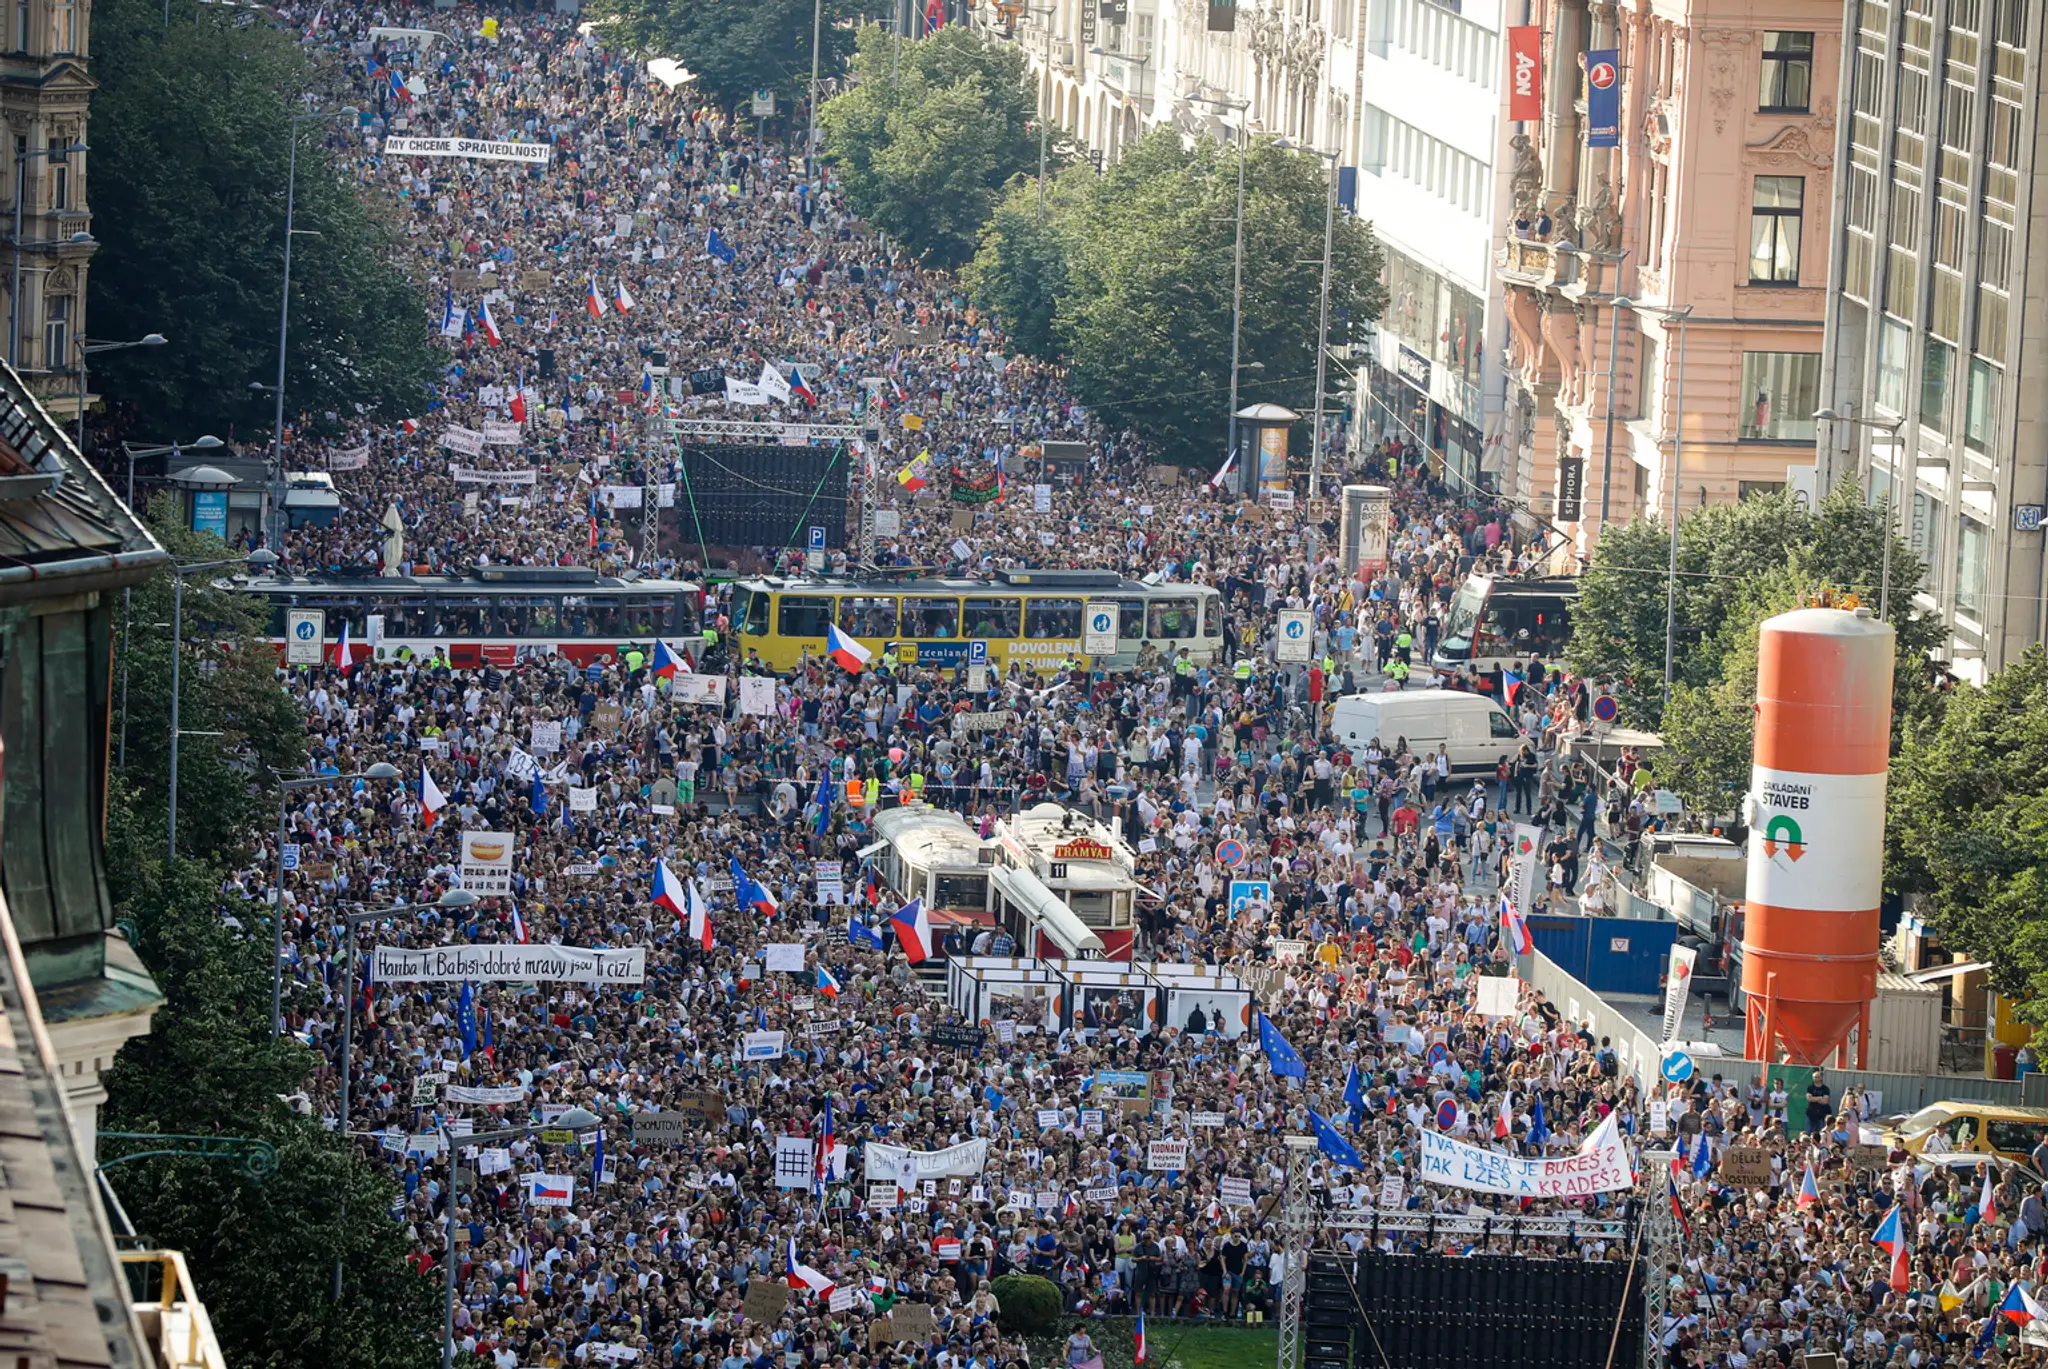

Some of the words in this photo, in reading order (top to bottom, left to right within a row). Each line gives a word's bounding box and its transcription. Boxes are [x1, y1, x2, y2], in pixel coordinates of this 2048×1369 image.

[1515, 51, 1535, 97] AON
[388, 139, 405, 150] MY
[409, 140, 451, 151] CHCEME
[457, 141, 548, 158] SPRAVEDLNOST!
[1566, 464, 1576, 515] SEPHORA
[1008, 640, 1082, 655] DOVOLENÁ
[1763, 780, 1813, 796] ZAKLÁDÁNÍ
[1762, 792, 1810, 810] STAVEB
[1056, 846, 1111, 859] TRAMVAJ
[1054, 864, 1065, 877] 11
[1278, 943, 1302, 951] POZOR
[378, 951, 418, 976] Hanba
[525, 958, 566, 979] mravy
[569, 958, 592, 977] jsou
[634, 1120, 682, 1131] CHOMUTOVA
[1423, 1128, 1456, 1155] TVÁ
[1461, 1145, 1511, 1175] VOLBA
[1517, 1160, 1539, 1177] JE
[1425, 1154, 1452, 1177] TAK
[1464, 1157, 1511, 1189] LŽEŠ
[1519, 1179, 1532, 1192] A
